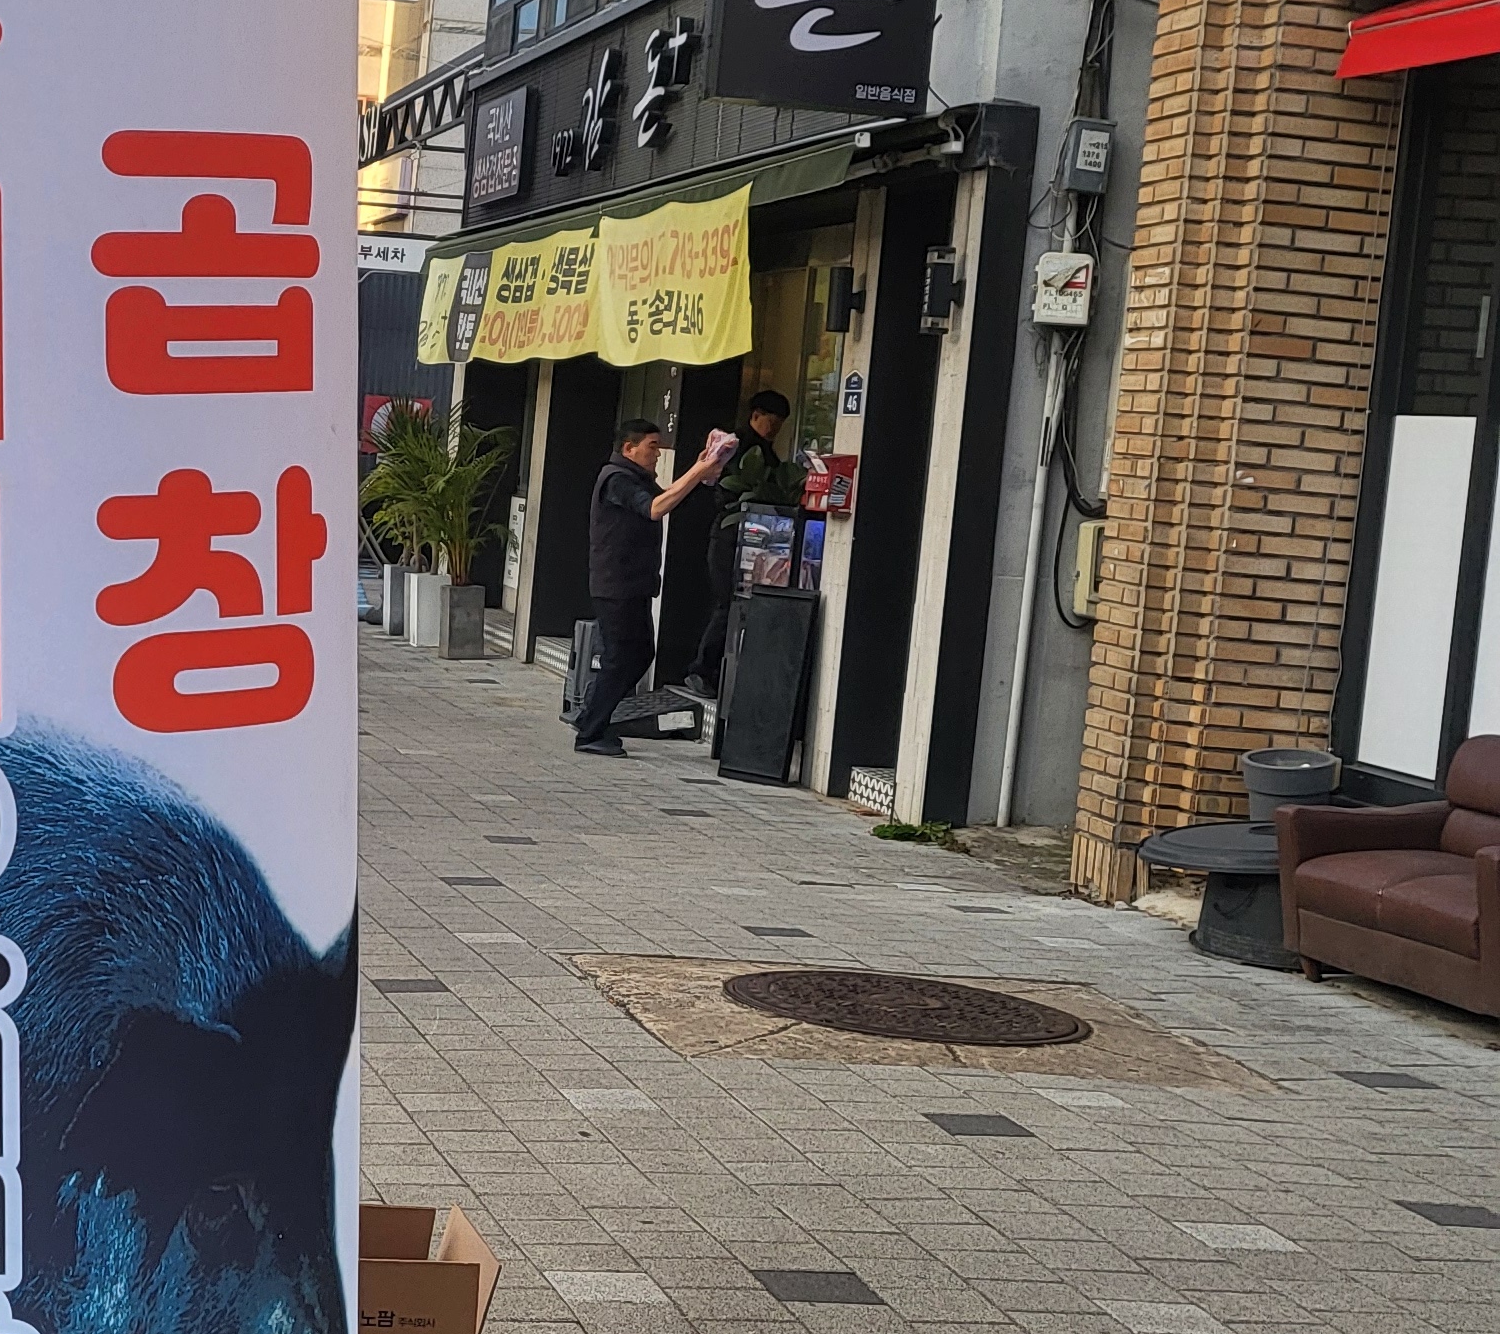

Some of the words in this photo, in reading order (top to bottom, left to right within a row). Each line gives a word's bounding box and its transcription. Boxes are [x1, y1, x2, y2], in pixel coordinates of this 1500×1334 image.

[855, 84, 916, 103] 일반음식점
[846, 394, 858, 412] 46
[90, 130, 327, 733] 곱창
